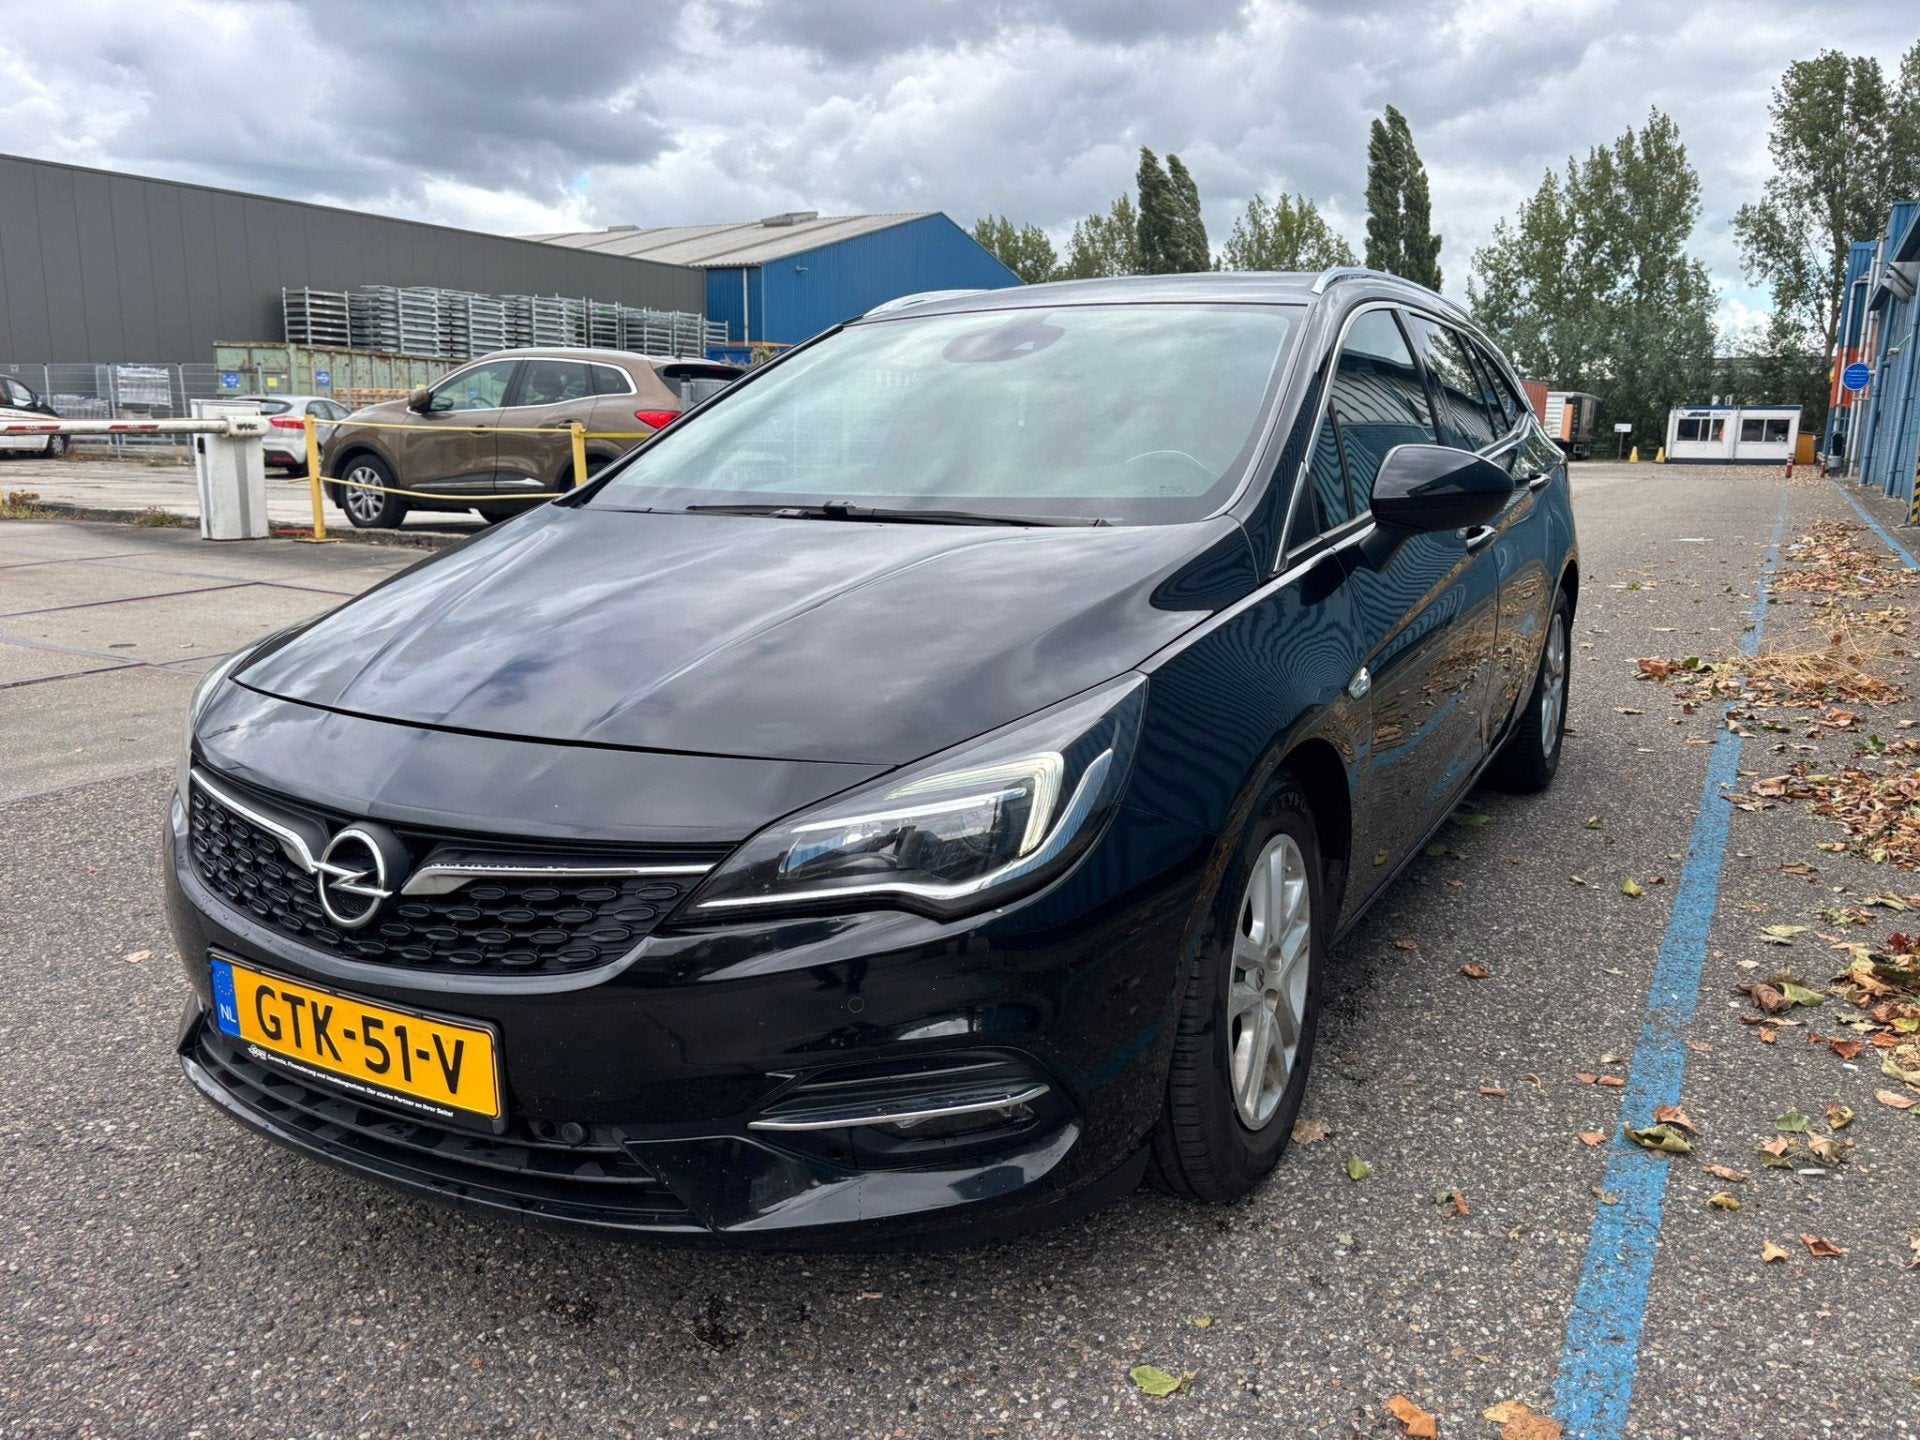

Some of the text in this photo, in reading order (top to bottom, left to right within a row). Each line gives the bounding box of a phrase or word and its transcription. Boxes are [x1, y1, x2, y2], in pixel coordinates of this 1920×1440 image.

[220, 1003, 237, 1023] NL
[255, 984, 464, 1094] GTK-51-V
[394, 1096, 414, 1106] Partner
